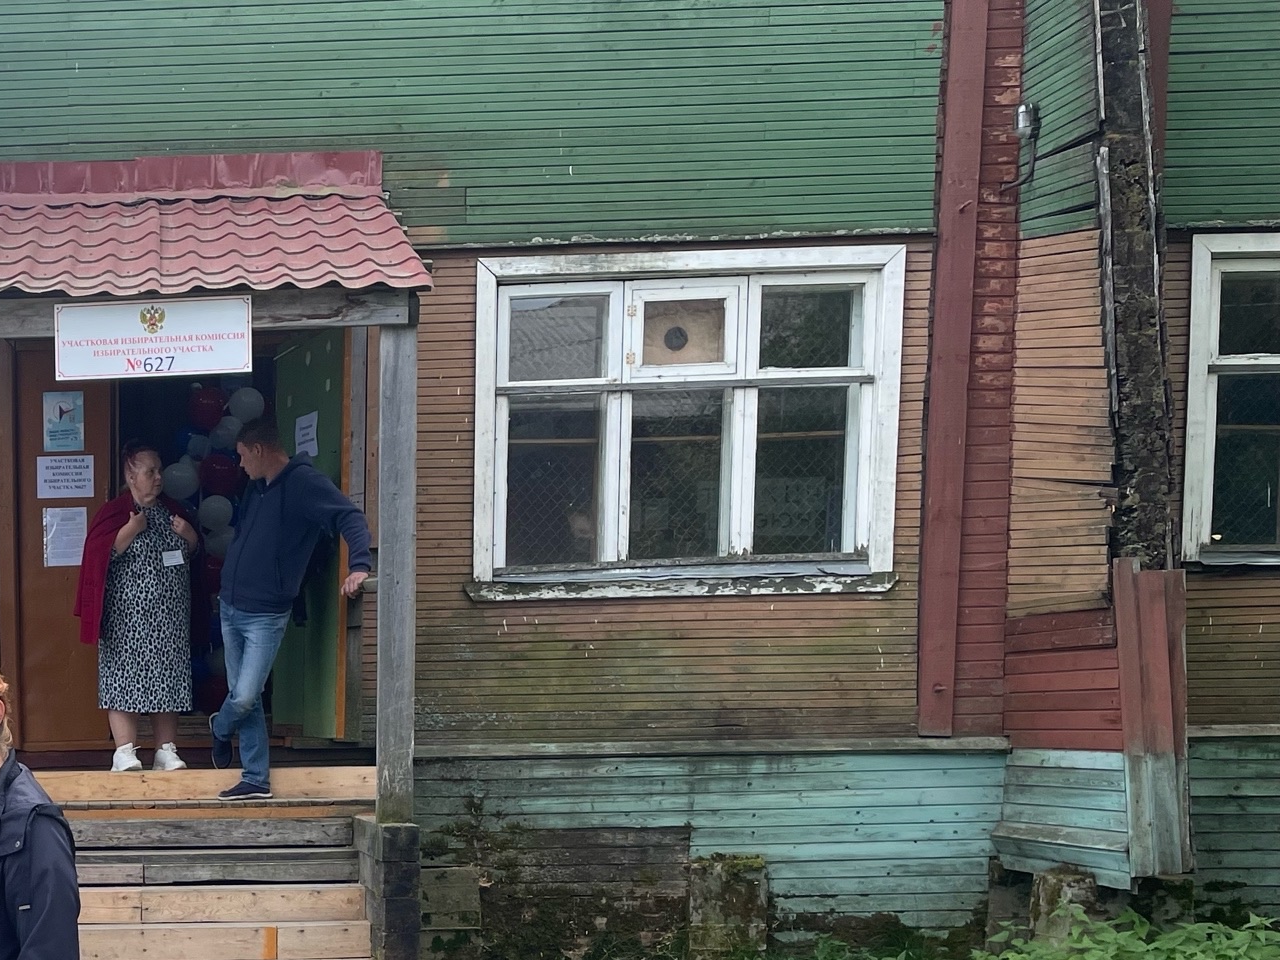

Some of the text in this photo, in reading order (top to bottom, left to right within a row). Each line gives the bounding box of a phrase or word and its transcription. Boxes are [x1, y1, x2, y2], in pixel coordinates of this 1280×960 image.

[62, 331, 245, 348] УЧАСТКОВАЯ ИЗБИРАТЕЛЬНАЯ КОМИССИЯ
[93, 345, 214, 357] ИЗБИРАТЕЛЬНОГО УЧАСТКА
